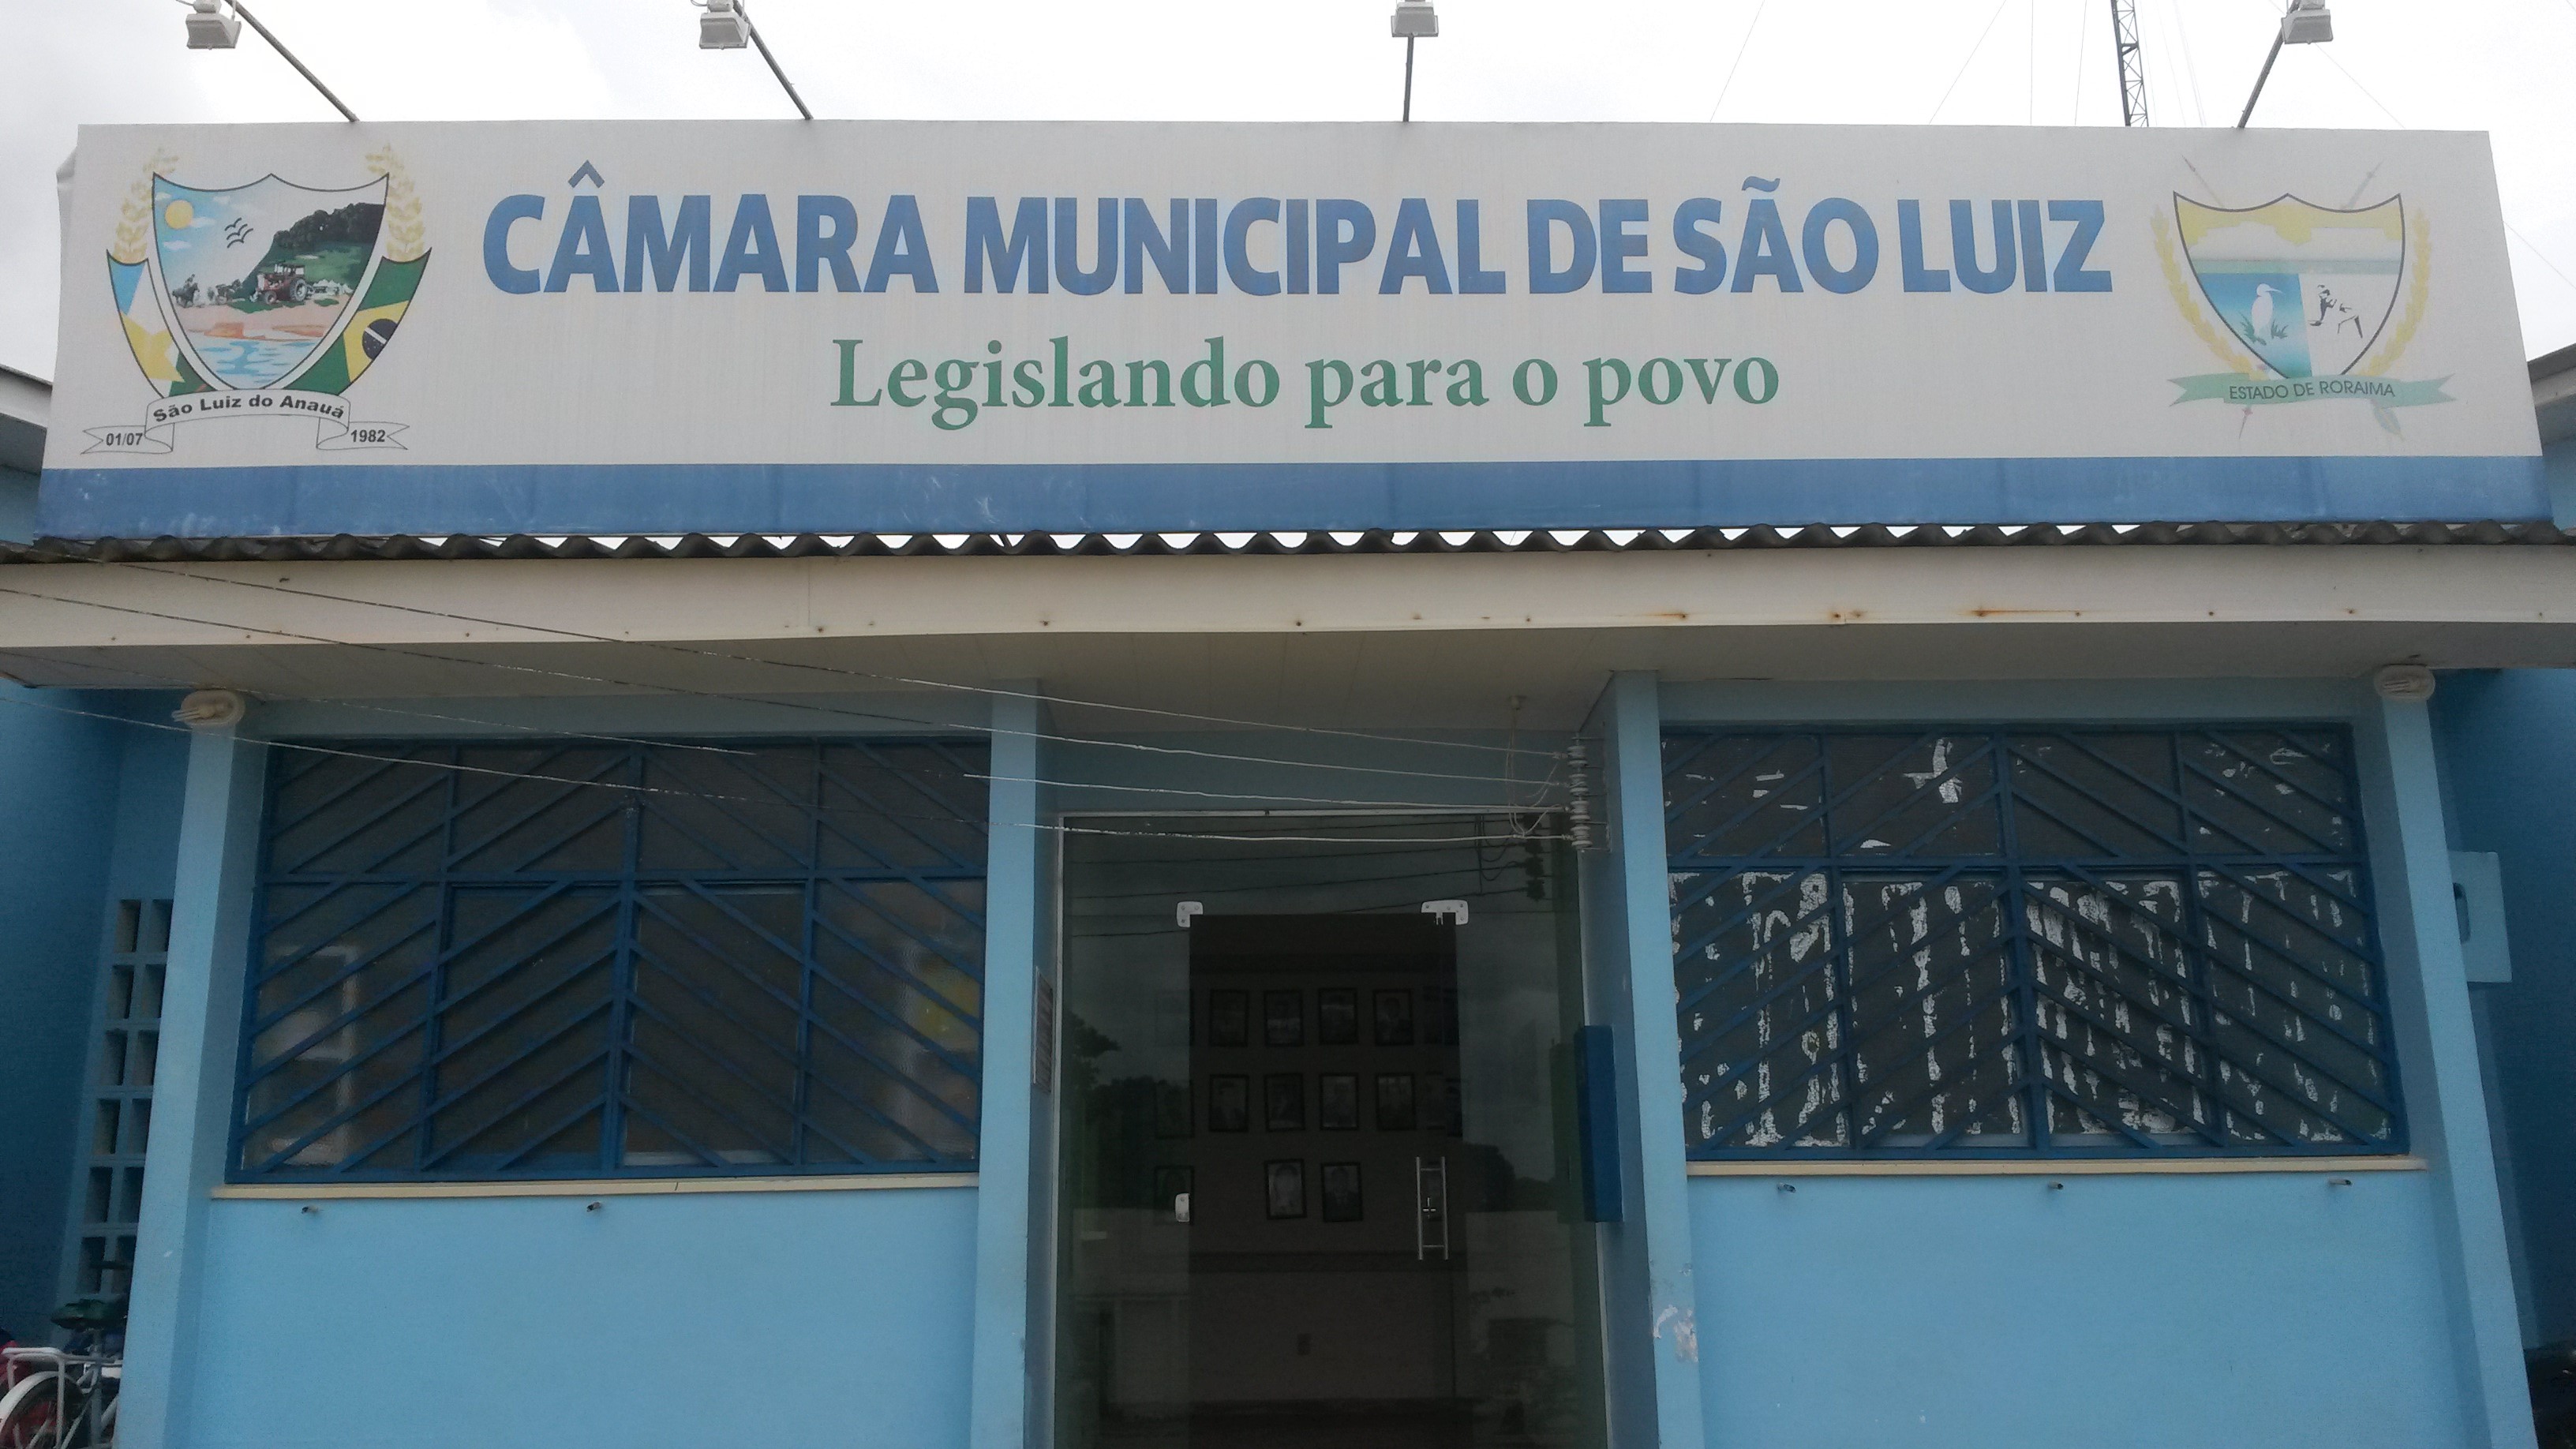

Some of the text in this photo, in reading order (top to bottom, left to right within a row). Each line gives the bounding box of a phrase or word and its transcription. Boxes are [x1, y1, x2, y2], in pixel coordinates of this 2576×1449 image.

[484, 160, 2113, 296] CÂMARA MUNICIPAL DE SÃO LUIZ
[830, 335, 1780, 431] Legislando para o povo
[2229, 380, 2396, 400] ESTADO DE RORAIMA
[152, 394, 345, 422] São Luiz do Anauá
[105, 432, 144, 447] 01/07
[350, 429, 387, 443] 1982
